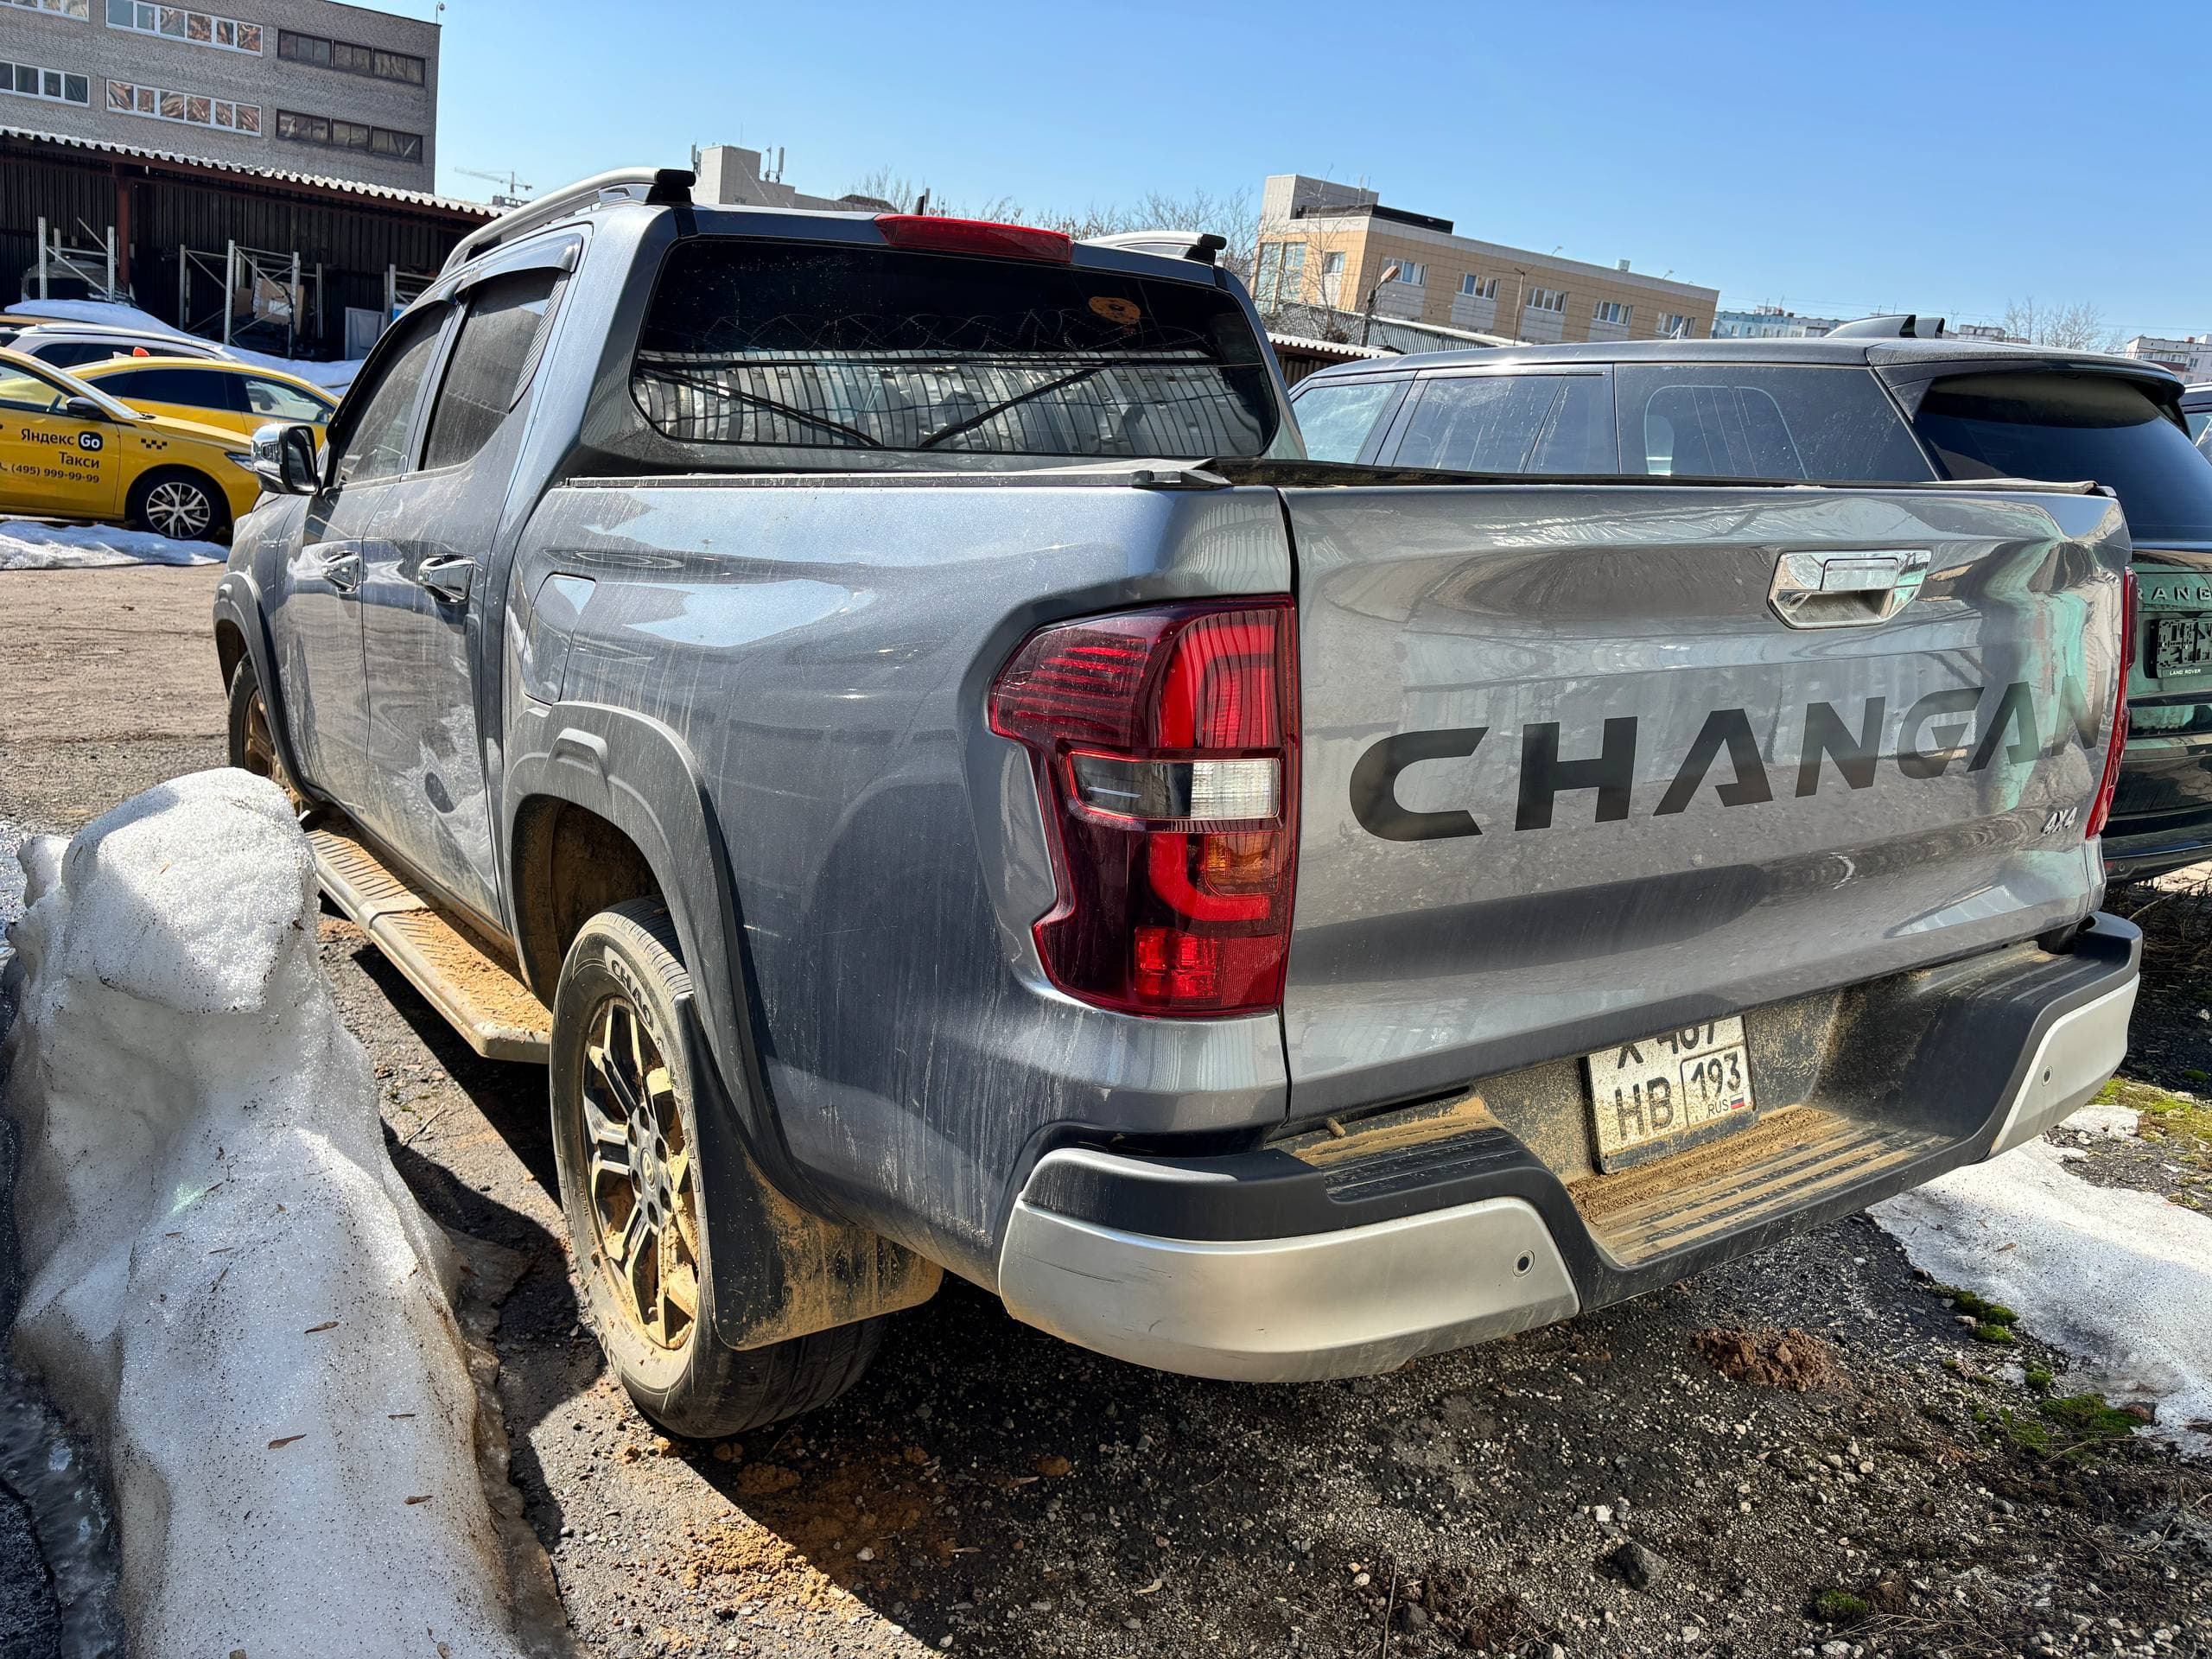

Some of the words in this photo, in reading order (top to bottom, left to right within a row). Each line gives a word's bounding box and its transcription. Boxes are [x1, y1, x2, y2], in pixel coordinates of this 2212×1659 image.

[21, 428, 74, 446] Яндекс
[80, 434, 100, 448] Go
[59, 451, 100, 469] Такси
[11, 463, 41, 477] (495)
[44, 467, 100, 484] 999-99-99
[1349, 671, 2107, 842] CHANGAN
[1691, 1051, 1741, 1100] 193
[1614, 1077, 1675, 1141] HB
[1707, 1098, 1728, 1116] RUS
